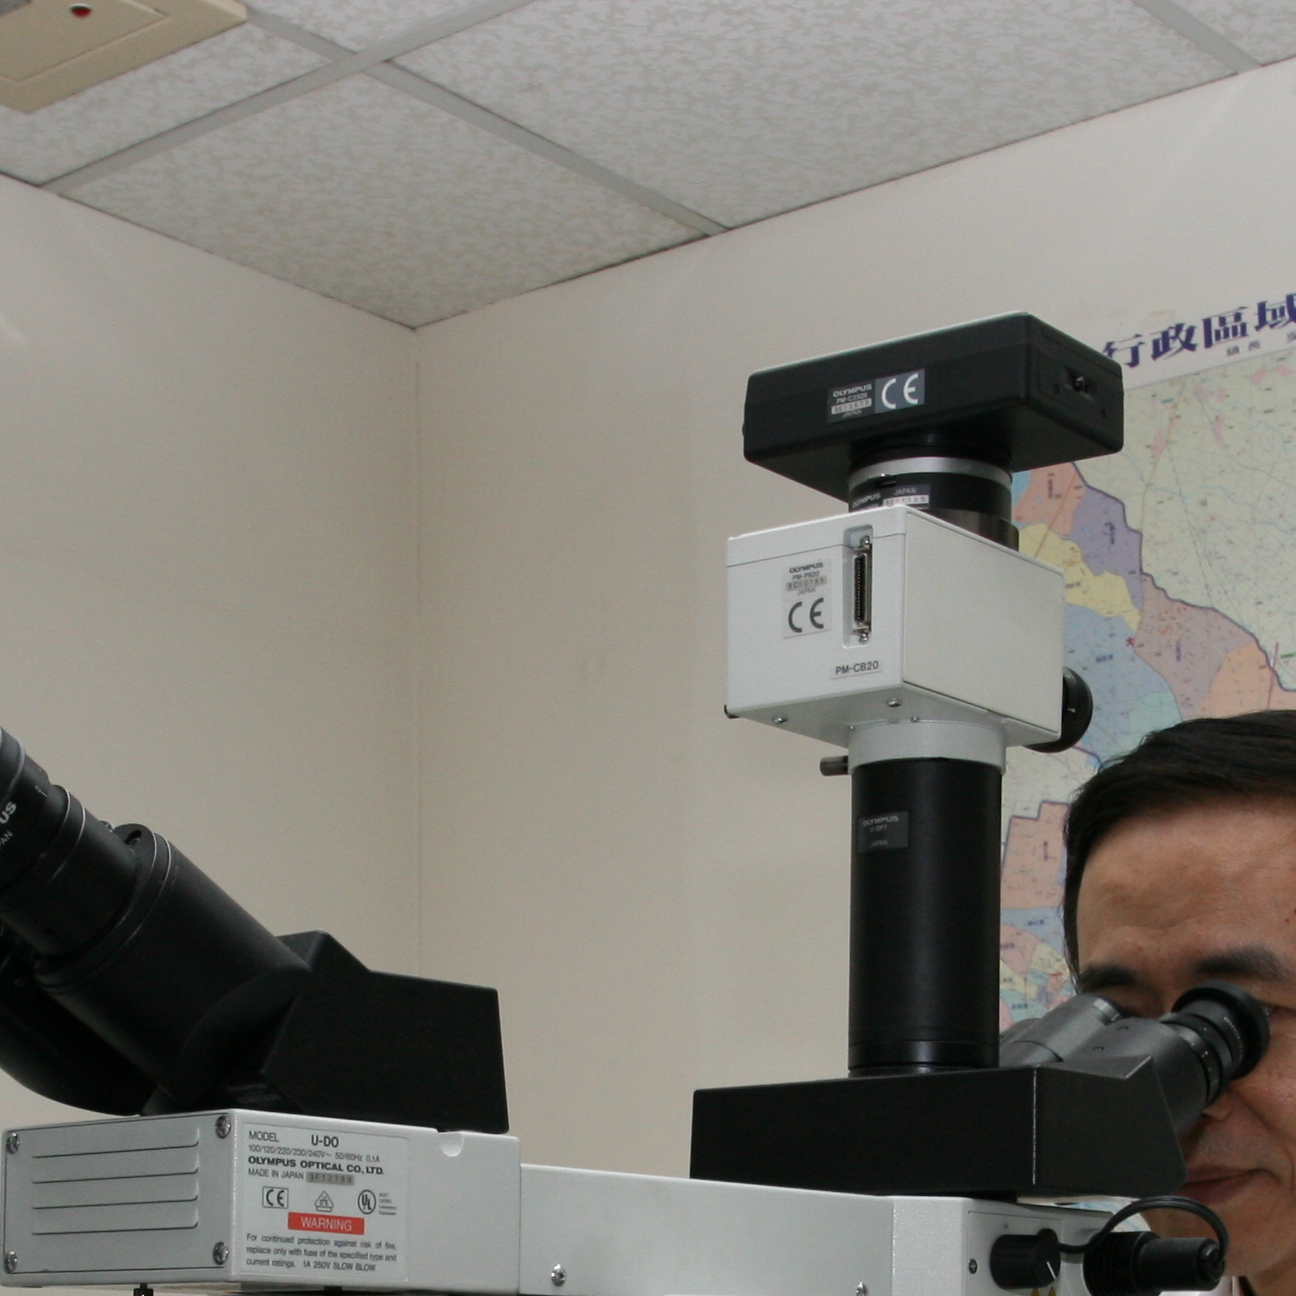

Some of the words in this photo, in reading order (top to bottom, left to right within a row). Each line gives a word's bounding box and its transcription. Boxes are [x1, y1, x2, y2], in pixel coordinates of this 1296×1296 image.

[833, 384, 872, 398] OLYMPUS
[881, 373, 919, 410] CE
[789, 562, 823, 574] OLYMPUS
[788, 597, 824, 633] CE
[835, 660, 879, 675] PM-CB20
[248, 1131, 279, 1143] MODEL
[311, 1135, 339, 1148] U-DO
[248, 1156, 297, 1167] OLYMPUS
[300, 1160, 343, 1172] OPTICAL
[248, 1168, 269, 1177] MADE
[271, 1170, 279, 1178] IN
[281, 1170, 304, 1180] JAPAN
[266, 1188, 285, 1207] CE
[301, 1216, 353, 1231] WARNING
[247, 1233, 258, 1242] For
[261, 1234, 295, 1244] continued
[297, 1237, 331, 1246] protection
[333, 1240, 357, 1249] against
[246, 1246, 272, 1255] replace
[273, 1248, 287, 1256] only
[288, 1248, 302, 1256] with
[303, 1249, 318, 1257] fuse
[319, 1249, 326, 1257] of
[327, 1250, 338, 1258] the
[339, 1251, 369, 1260] specified
[369, 1253, 383, 1262] type
[385, 1254, 397, 1262] and
[246, 1258, 271, 1266] current
[313, 1261, 331, 1269] 250V
[333, 1261, 354, 1270] SLOW
[355, 1263, 376, 1272] BLOW
